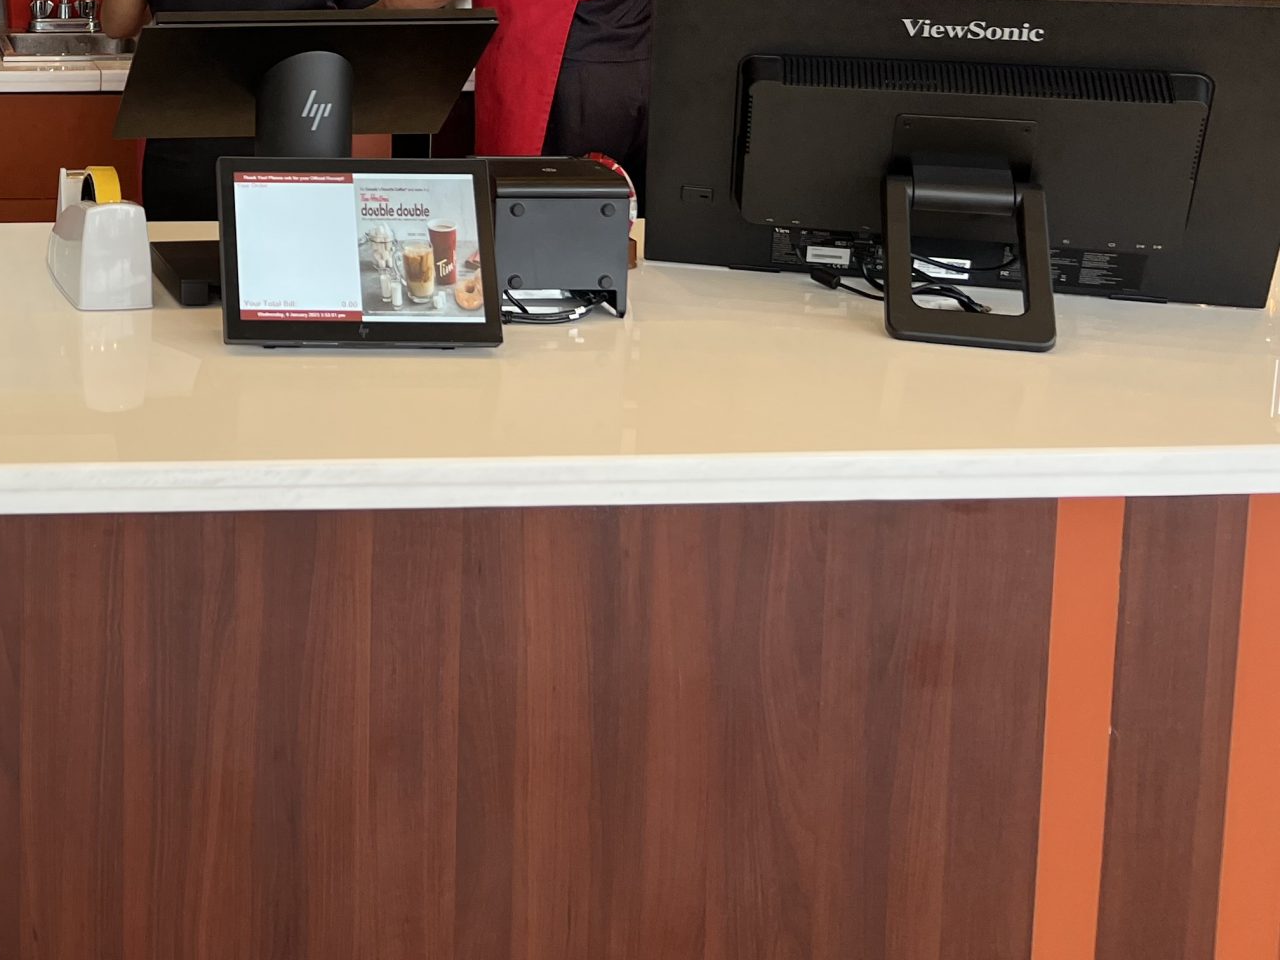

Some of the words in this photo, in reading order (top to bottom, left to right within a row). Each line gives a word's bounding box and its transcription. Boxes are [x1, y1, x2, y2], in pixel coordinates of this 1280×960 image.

[901, 18, 1045, 41] ViewSonic
[361, 203, 394, 217] double
[396, 203, 430, 217] double
[436, 258, 453, 278] Tim
